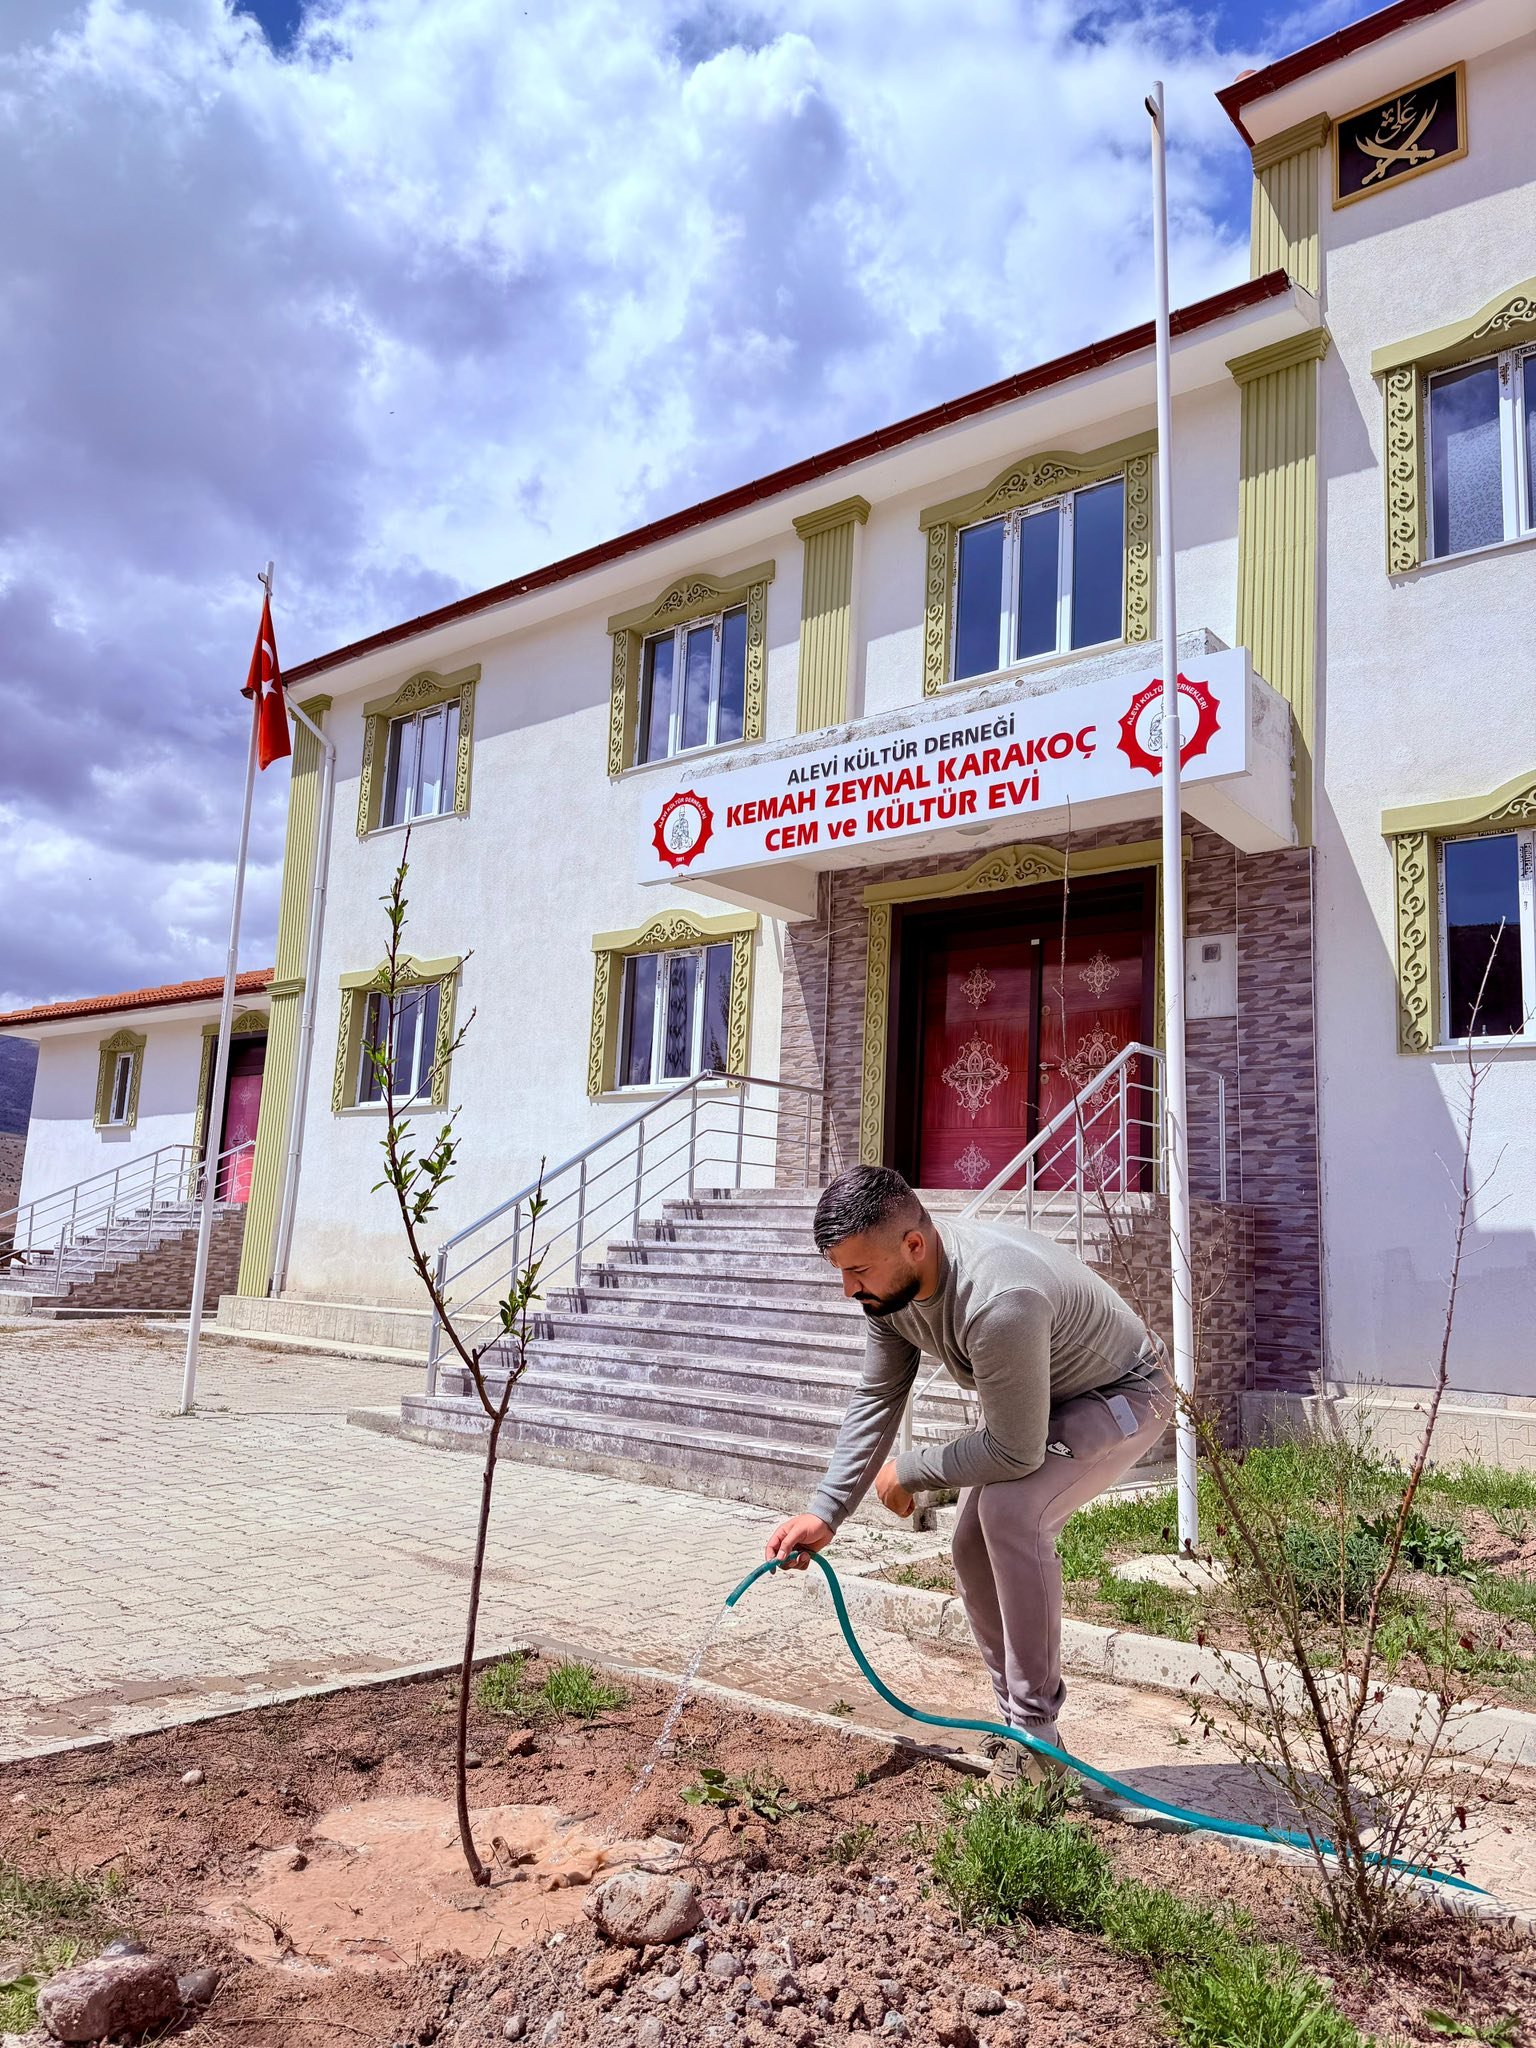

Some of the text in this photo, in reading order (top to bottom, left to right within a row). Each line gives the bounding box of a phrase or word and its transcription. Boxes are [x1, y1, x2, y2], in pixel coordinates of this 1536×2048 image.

[1177, 683, 1208, 710] ERNEKLERİ
[726, 725, 1097, 828] KEMAH ZEYNAL KARAKOÇ
[787, 712, 1015, 786] ALEVİ KÜLTÜR DERNEĞİ
[765, 769, 1040, 852] CEM ve KÜLTÜR EVİ
